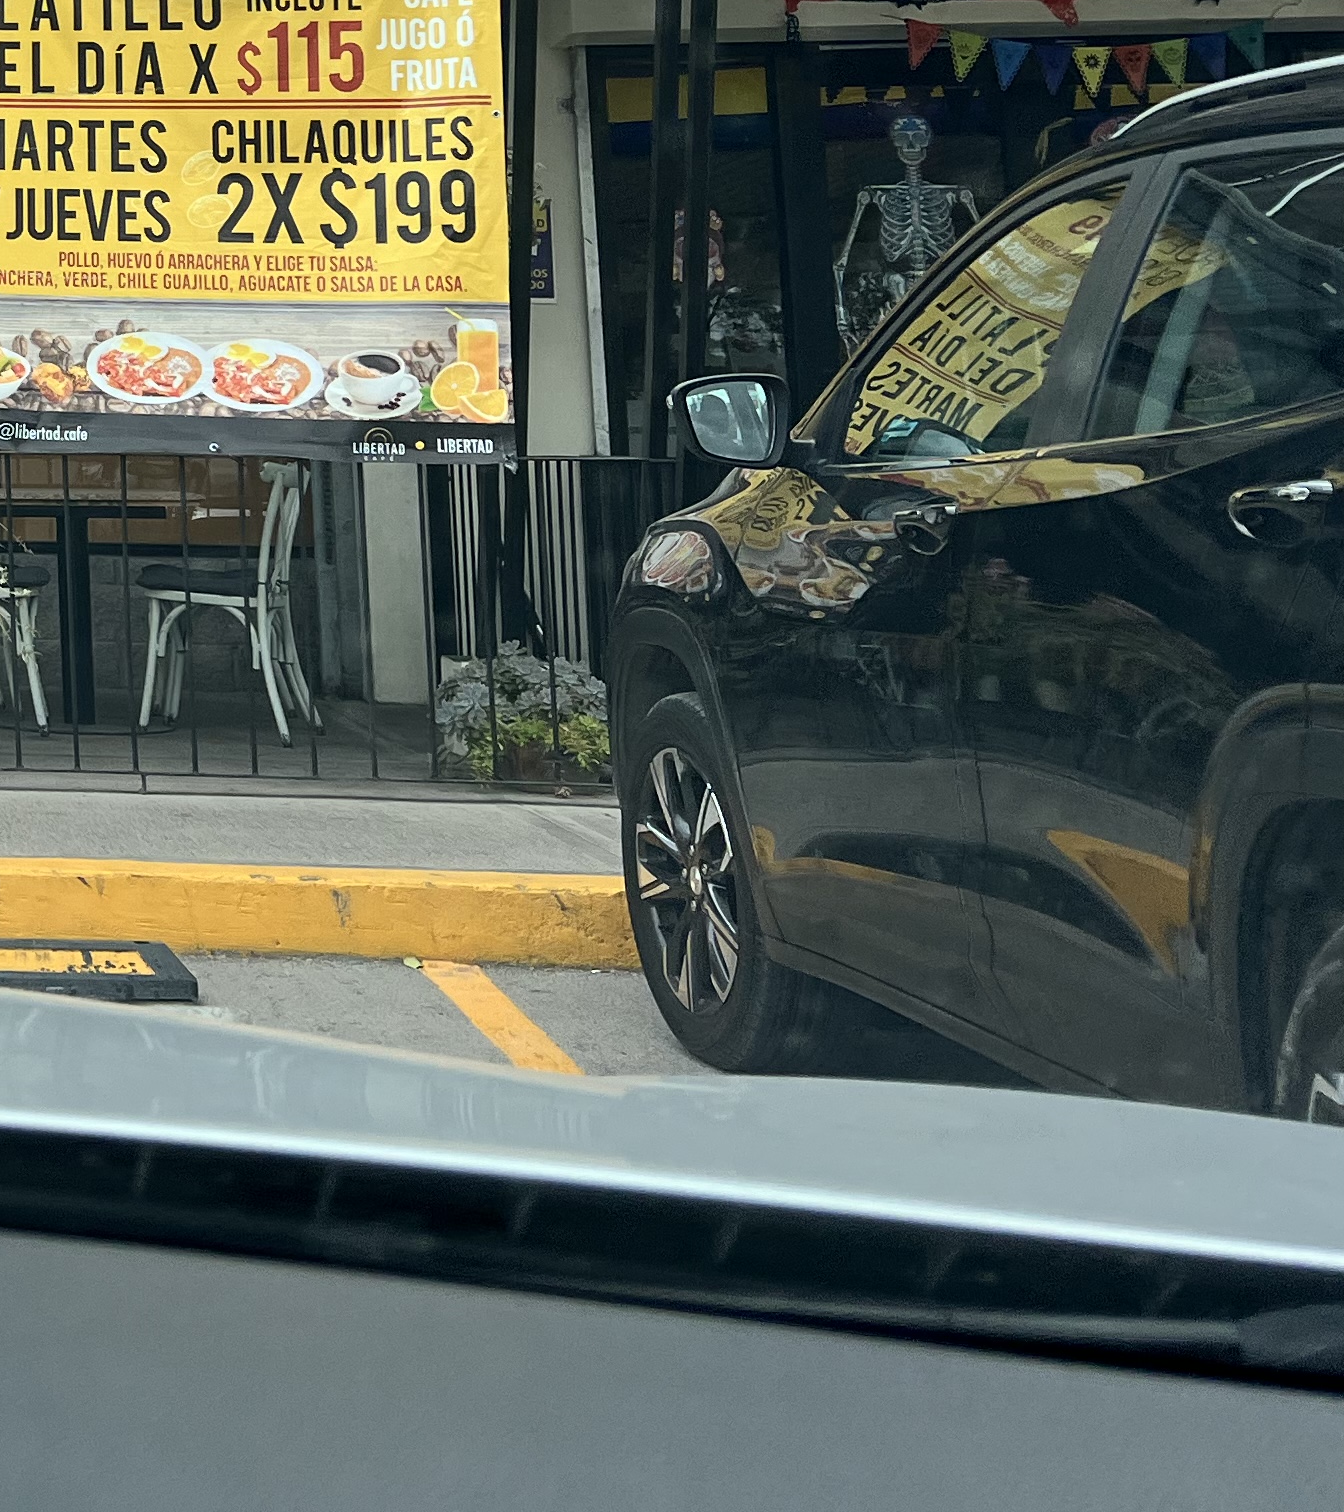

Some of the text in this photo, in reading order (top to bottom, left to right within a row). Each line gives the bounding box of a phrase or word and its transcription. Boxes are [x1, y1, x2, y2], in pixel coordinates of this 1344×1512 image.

[376, 12, 474, 51] JUGO Ó
[189, 43, 219, 95] X
[237, 20, 365, 96] $115
[390, 57, 478, 92] FRUTA
[212, 116, 475, 166] CHILAQUILES
[6, 188, 171, 243] JUEVES
[217, 167, 477, 250] 2X $199
[59, 251, 104, 270] POLLO,
[108, 252, 151, 269] HUEVO
[168, 253, 250, 271] ARRACHERA
[254, 255, 262, 272] Y
[267, 255, 304, 272] ELIGE
[309, 256, 325, 272] TU
[62, 272, 112, 290] VERDE,
[118, 273, 158, 289] CHILE
[163, 274, 233, 293] GUAJILLO,
[239, 275, 311, 292] AGUACATE
[316, 276, 325, 292] O
[330, 276, 375, 292] SALSA
[380, 276, 398, 292] DE
[403, 276, 420, 292] LA
[426, 275, 468, 293] CASA.
[352, 442, 406, 456] LIBERTAD
[437, 438, 494, 454] LIBERTAD
